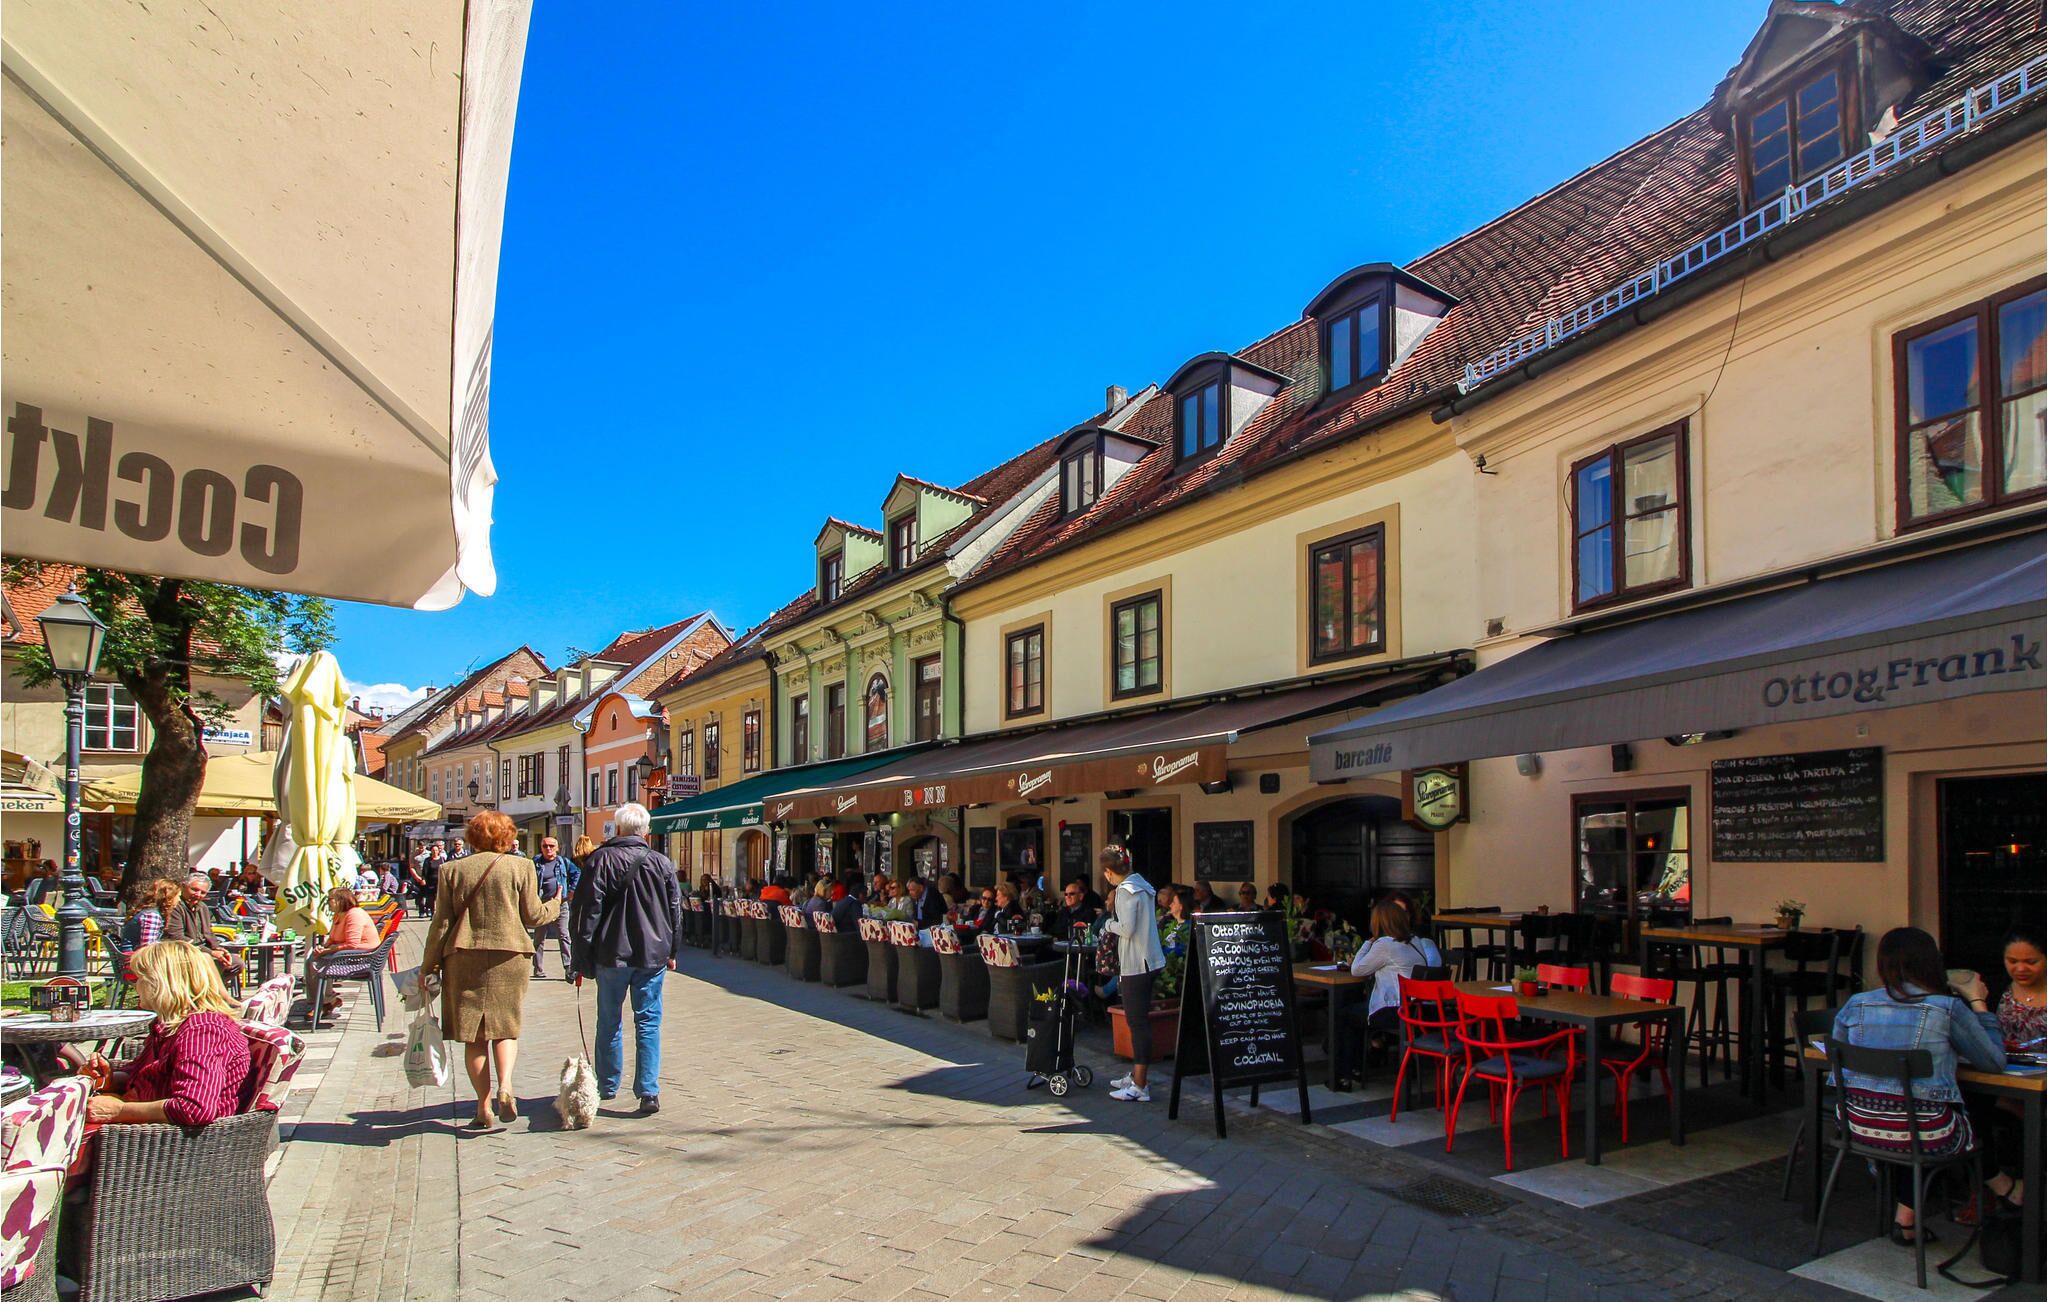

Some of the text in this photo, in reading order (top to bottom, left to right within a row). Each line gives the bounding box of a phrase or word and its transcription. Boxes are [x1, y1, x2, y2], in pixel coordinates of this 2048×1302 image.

[1763, 634, 2043, 707] Otto&Frank
[1335, 743, 1392, 769] barcaffé
[1152, 751, 1199, 783] Staropramen
[1018, 770, 1052, 798] Staropramen
[1417, 781, 1456, 808] Staropramen
[1212, 924, 1265, 937] Otto&Frank
[1208, 956, 1252, 967] FABULOUS
[1220, 999, 1284, 1012] NOVINOPHOBIA
[1220, 1038, 1239, 1046] KEEP
[1233, 1051, 1284, 1066] COCKTAIL
